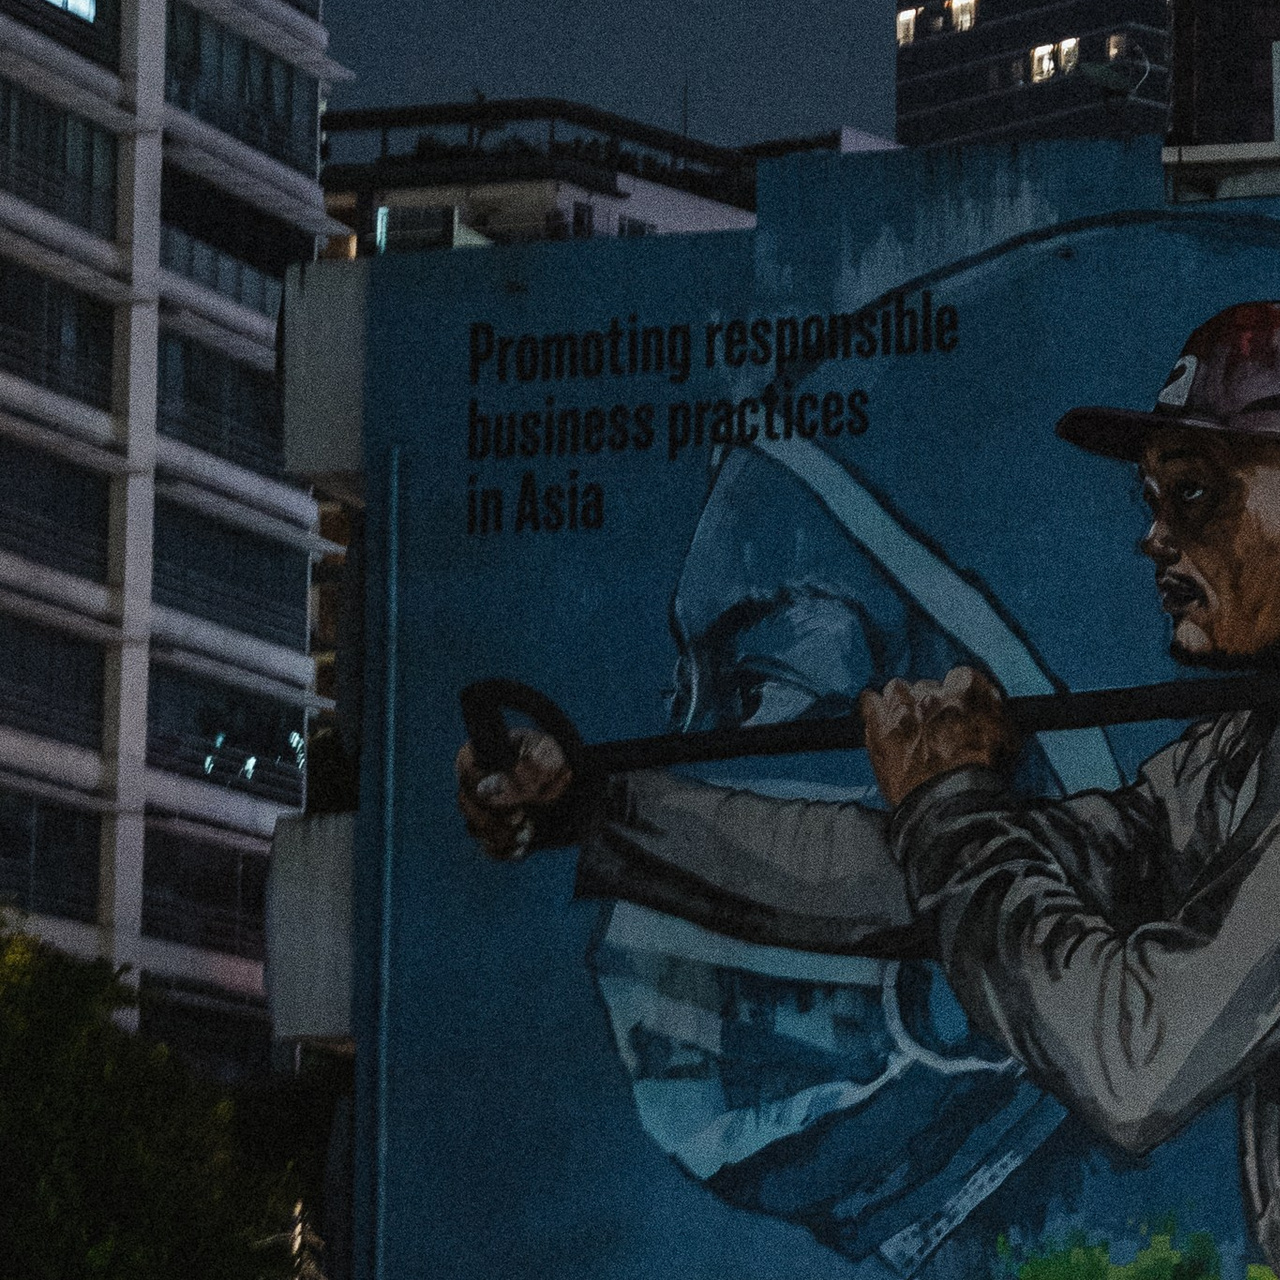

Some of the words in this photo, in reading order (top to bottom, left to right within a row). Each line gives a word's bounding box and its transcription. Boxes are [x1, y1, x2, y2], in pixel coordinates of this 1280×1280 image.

[469, 313, 693, 384] Promoting
[705, 290, 961, 376] responsible
[468, 396, 655, 462] business
[668, 381, 871, 461] practices
[467, 474, 502, 535] in
[514, 469, 604, 534] Asia
